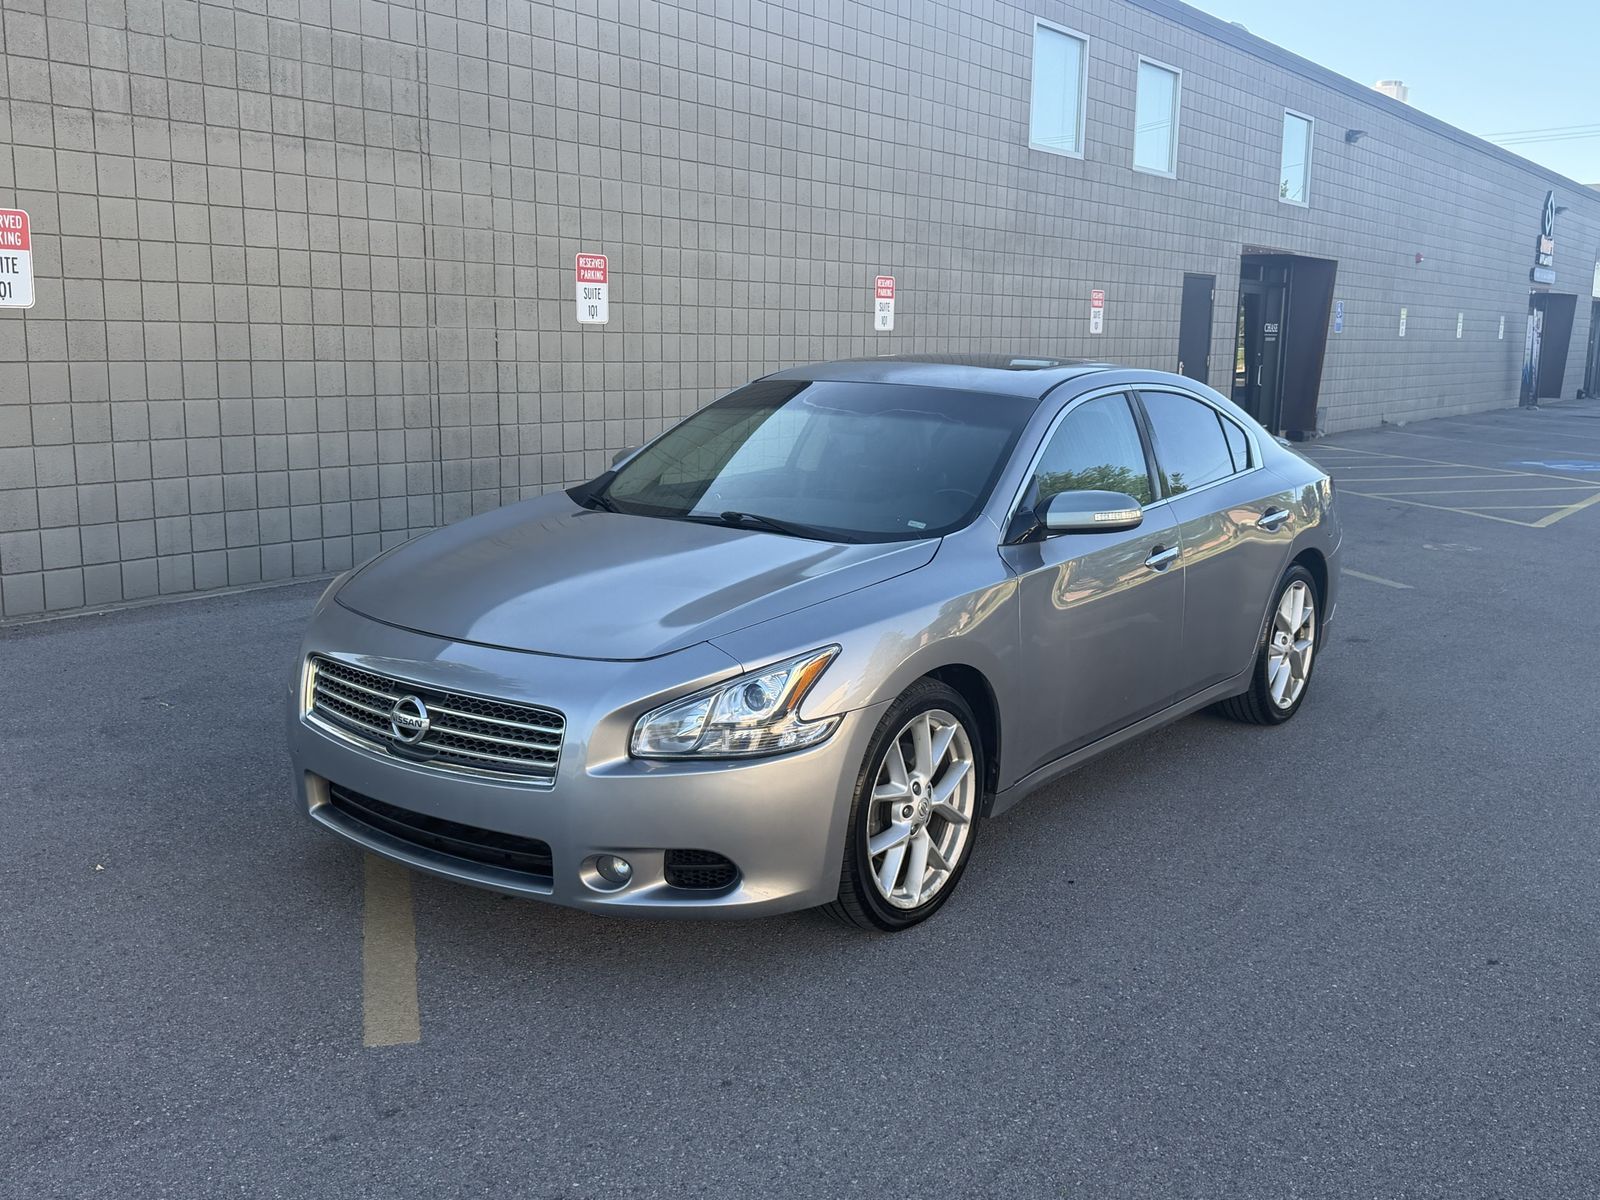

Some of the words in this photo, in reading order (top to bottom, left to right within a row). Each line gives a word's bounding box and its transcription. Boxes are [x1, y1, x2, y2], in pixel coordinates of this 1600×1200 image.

[579, 257, 605, 269] RESERVED
[580, 269, 604, 281] PARKING
[583, 287, 602, 301] SUITE
[391, 712, 423, 728] NISSAN
